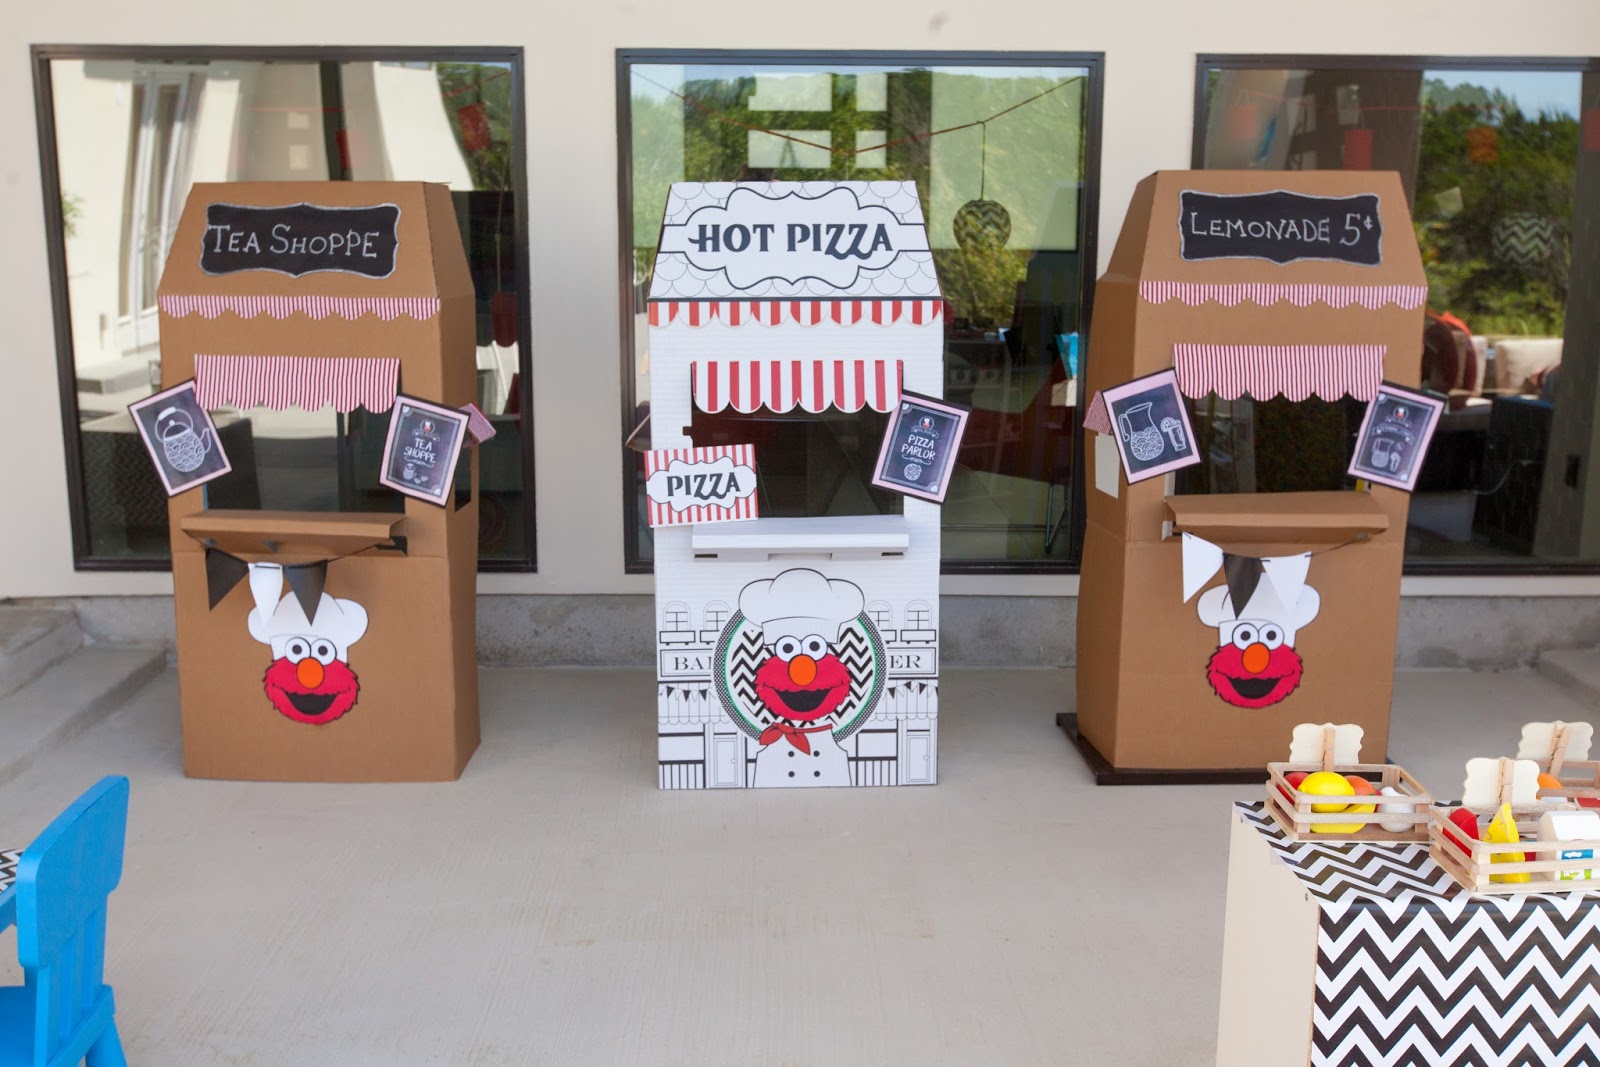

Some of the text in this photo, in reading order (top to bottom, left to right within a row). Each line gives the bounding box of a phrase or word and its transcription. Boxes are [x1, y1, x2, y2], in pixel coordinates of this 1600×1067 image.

[1191, 212, 1330, 244] LEMONADE
[208, 223, 380, 259] TEA SHOPPE
[688, 223, 893, 260] HOT PIZZA
[415, 437, 433, 451] TEA
[901, 443, 937, 461] PARLOR
[908, 434, 935, 449] PIZZA
[403, 446, 437, 464] SHOPPE
[666, 471, 741, 501] PIZZA
